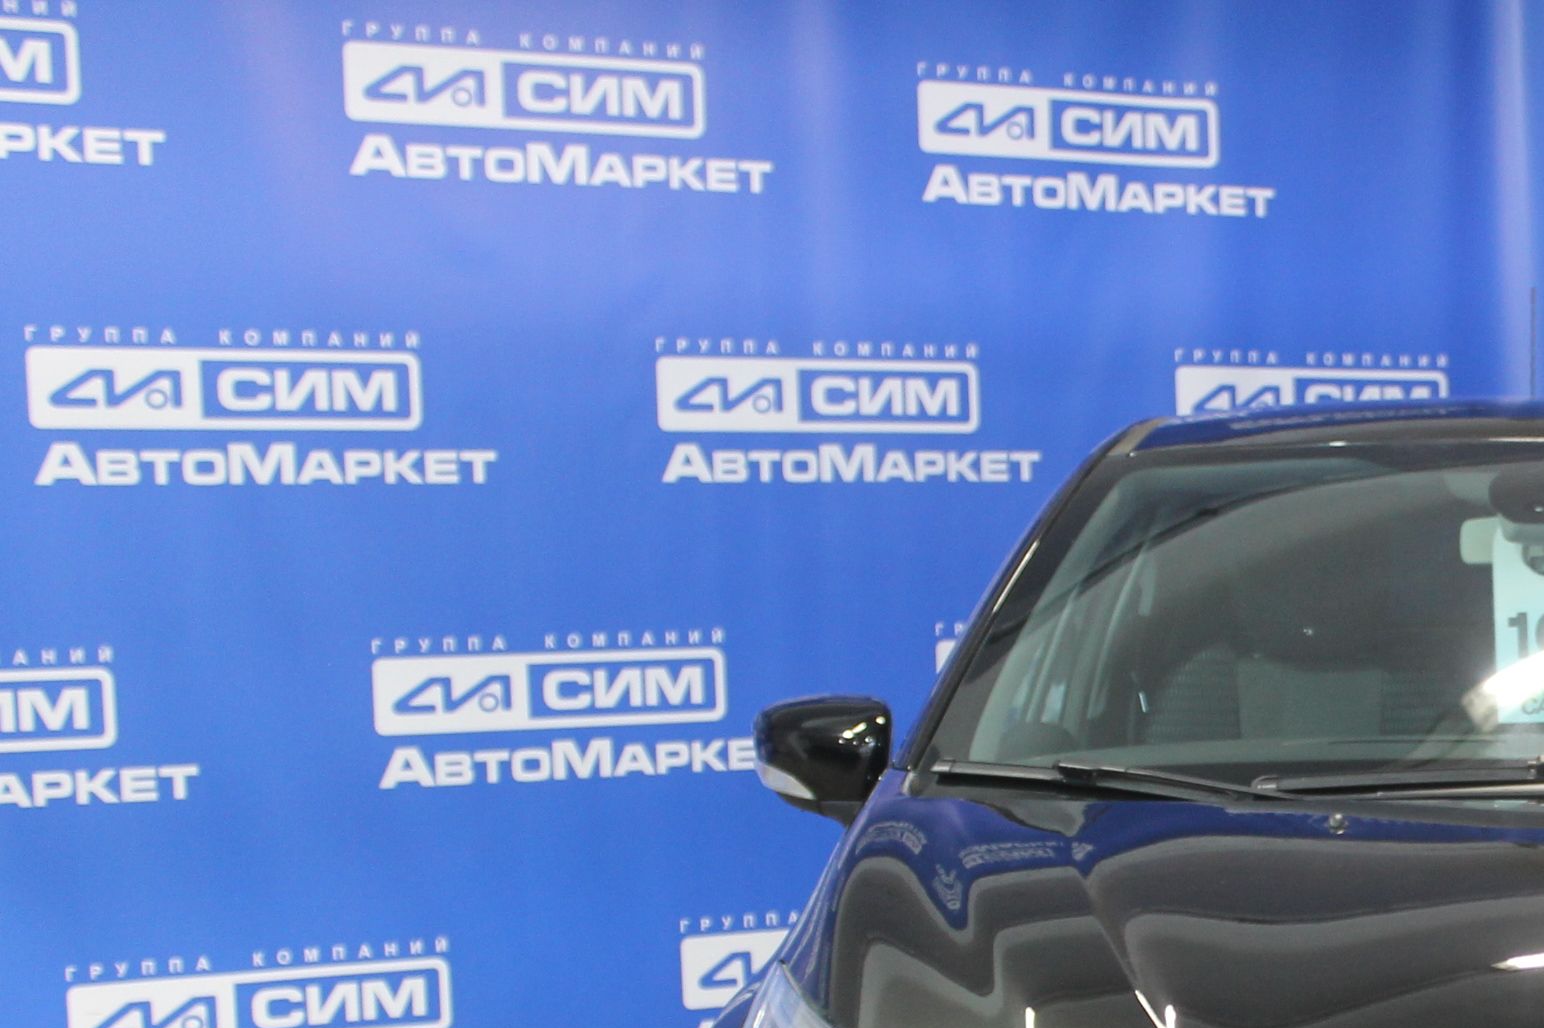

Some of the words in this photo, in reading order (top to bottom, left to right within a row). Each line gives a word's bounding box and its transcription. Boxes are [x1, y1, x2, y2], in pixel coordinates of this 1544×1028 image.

[342, 21, 480, 45] ГРУППА
[520, 33, 703, 59] КОМПАНИЙ
[517, 70, 681, 119] СИМ
[917, 62, 1031, 83] ГРУППА
[1064, 74, 1217, 96] КОМПАНИЙ
[1061, 107, 1199, 151] СИМ
[24, 324, 175, 343] ГРУППА
[219, 329, 419, 347] КОМПАНИЙ
[656, 337, 777, 353] ГРУППА
[813, 341, 977, 357] КОМПАНИЙ
[217, 368, 396, 411] СИМ
[811, 376, 959, 415] СИМ
[371, 636, 505, 654] ГРУППА
[545, 628, 724, 648] КОМПАНИЙ
[543, 666, 704, 710] СИМ
[65, 957, 209, 981] ГРУППА
[253, 937, 447, 966] КОМПАНИЙ
[251, 977, 426, 1028] СИМ
